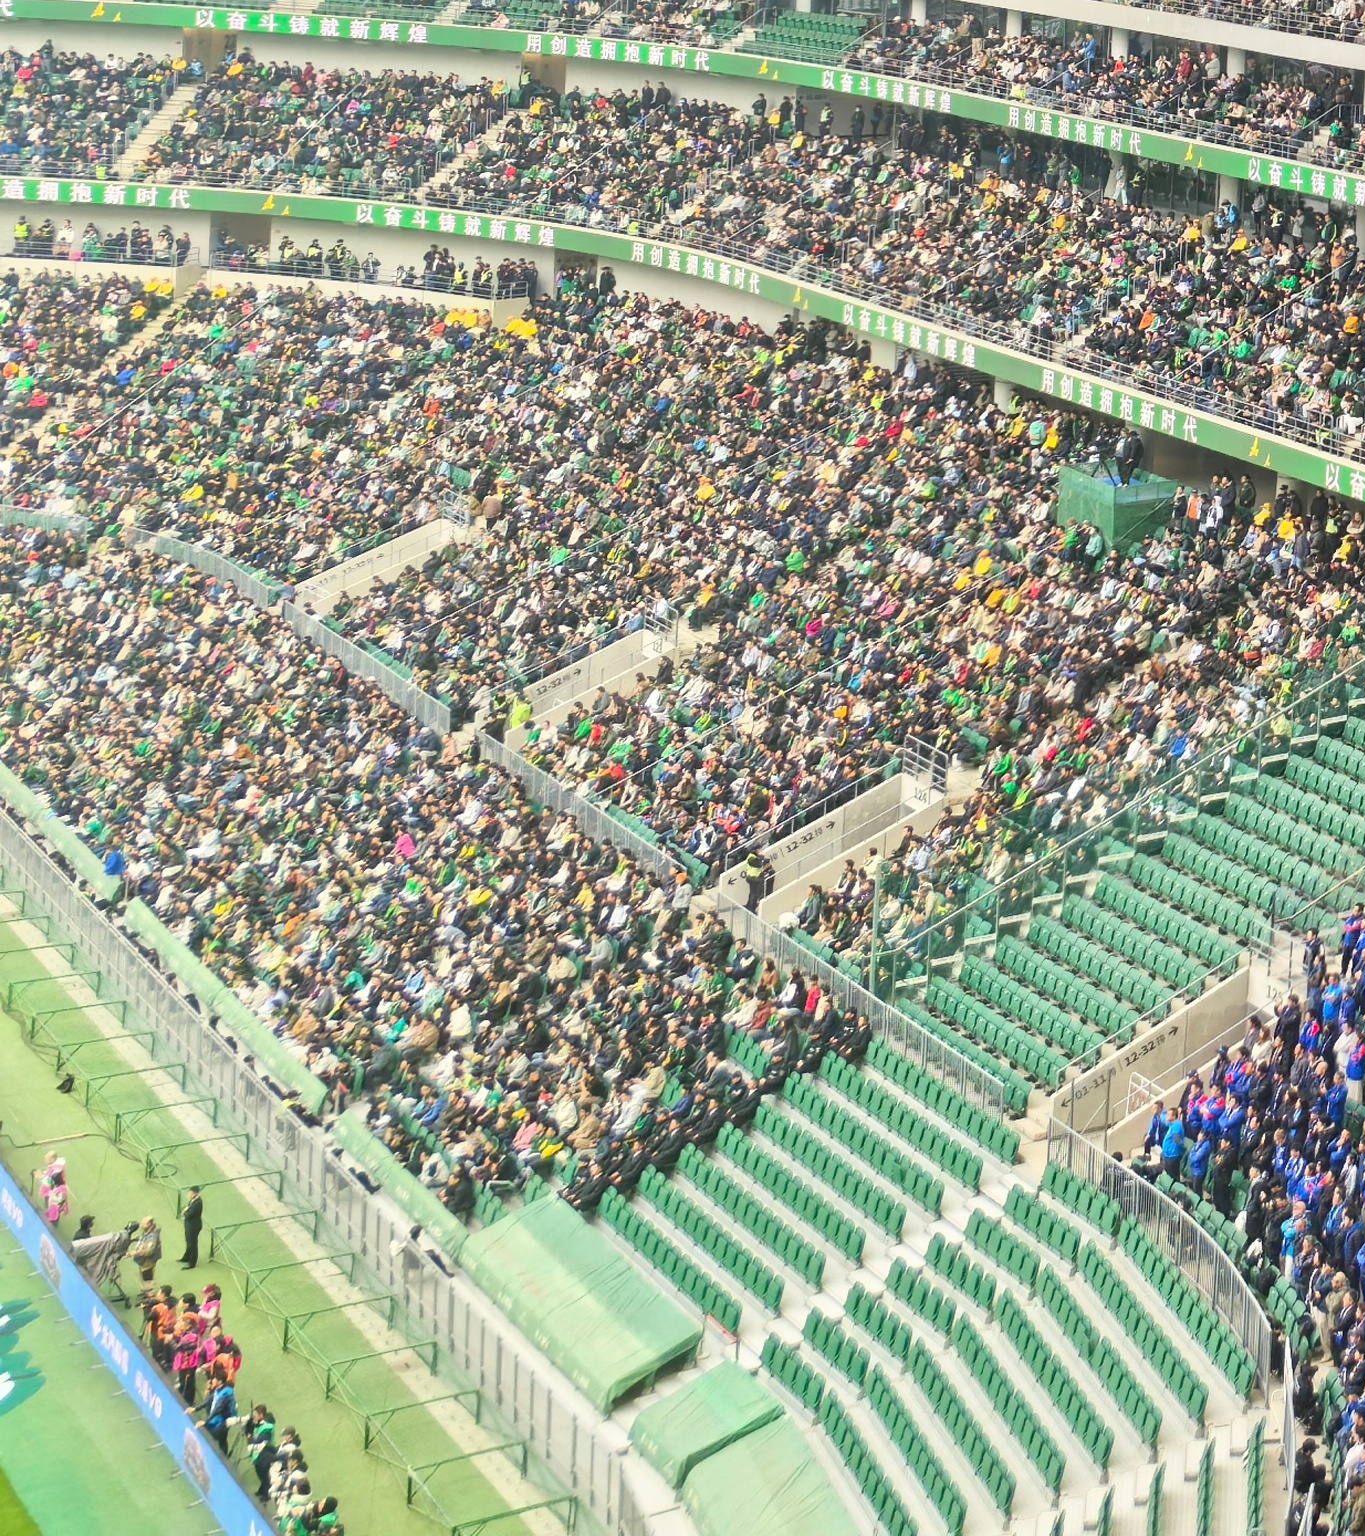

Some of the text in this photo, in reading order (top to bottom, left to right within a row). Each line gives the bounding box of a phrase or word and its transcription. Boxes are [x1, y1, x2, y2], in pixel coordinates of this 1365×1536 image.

[194, 9, 429, 45] 以奋斗铸就新辉煌
[525, 33, 714, 72] 用创造拥抱新时代
[821, 68, 954, 114] 以奋斗铸就新辉煌
[1008, 105, 1143, 159] 用创造拥抱新时代
[355, 203, 556, 248] 以奋斗铸就新辉煌
[630, 241, 761, 295] 用创造拥抱新时代
[842, 303, 976, 365] 以奋斗铸就新辉煌
